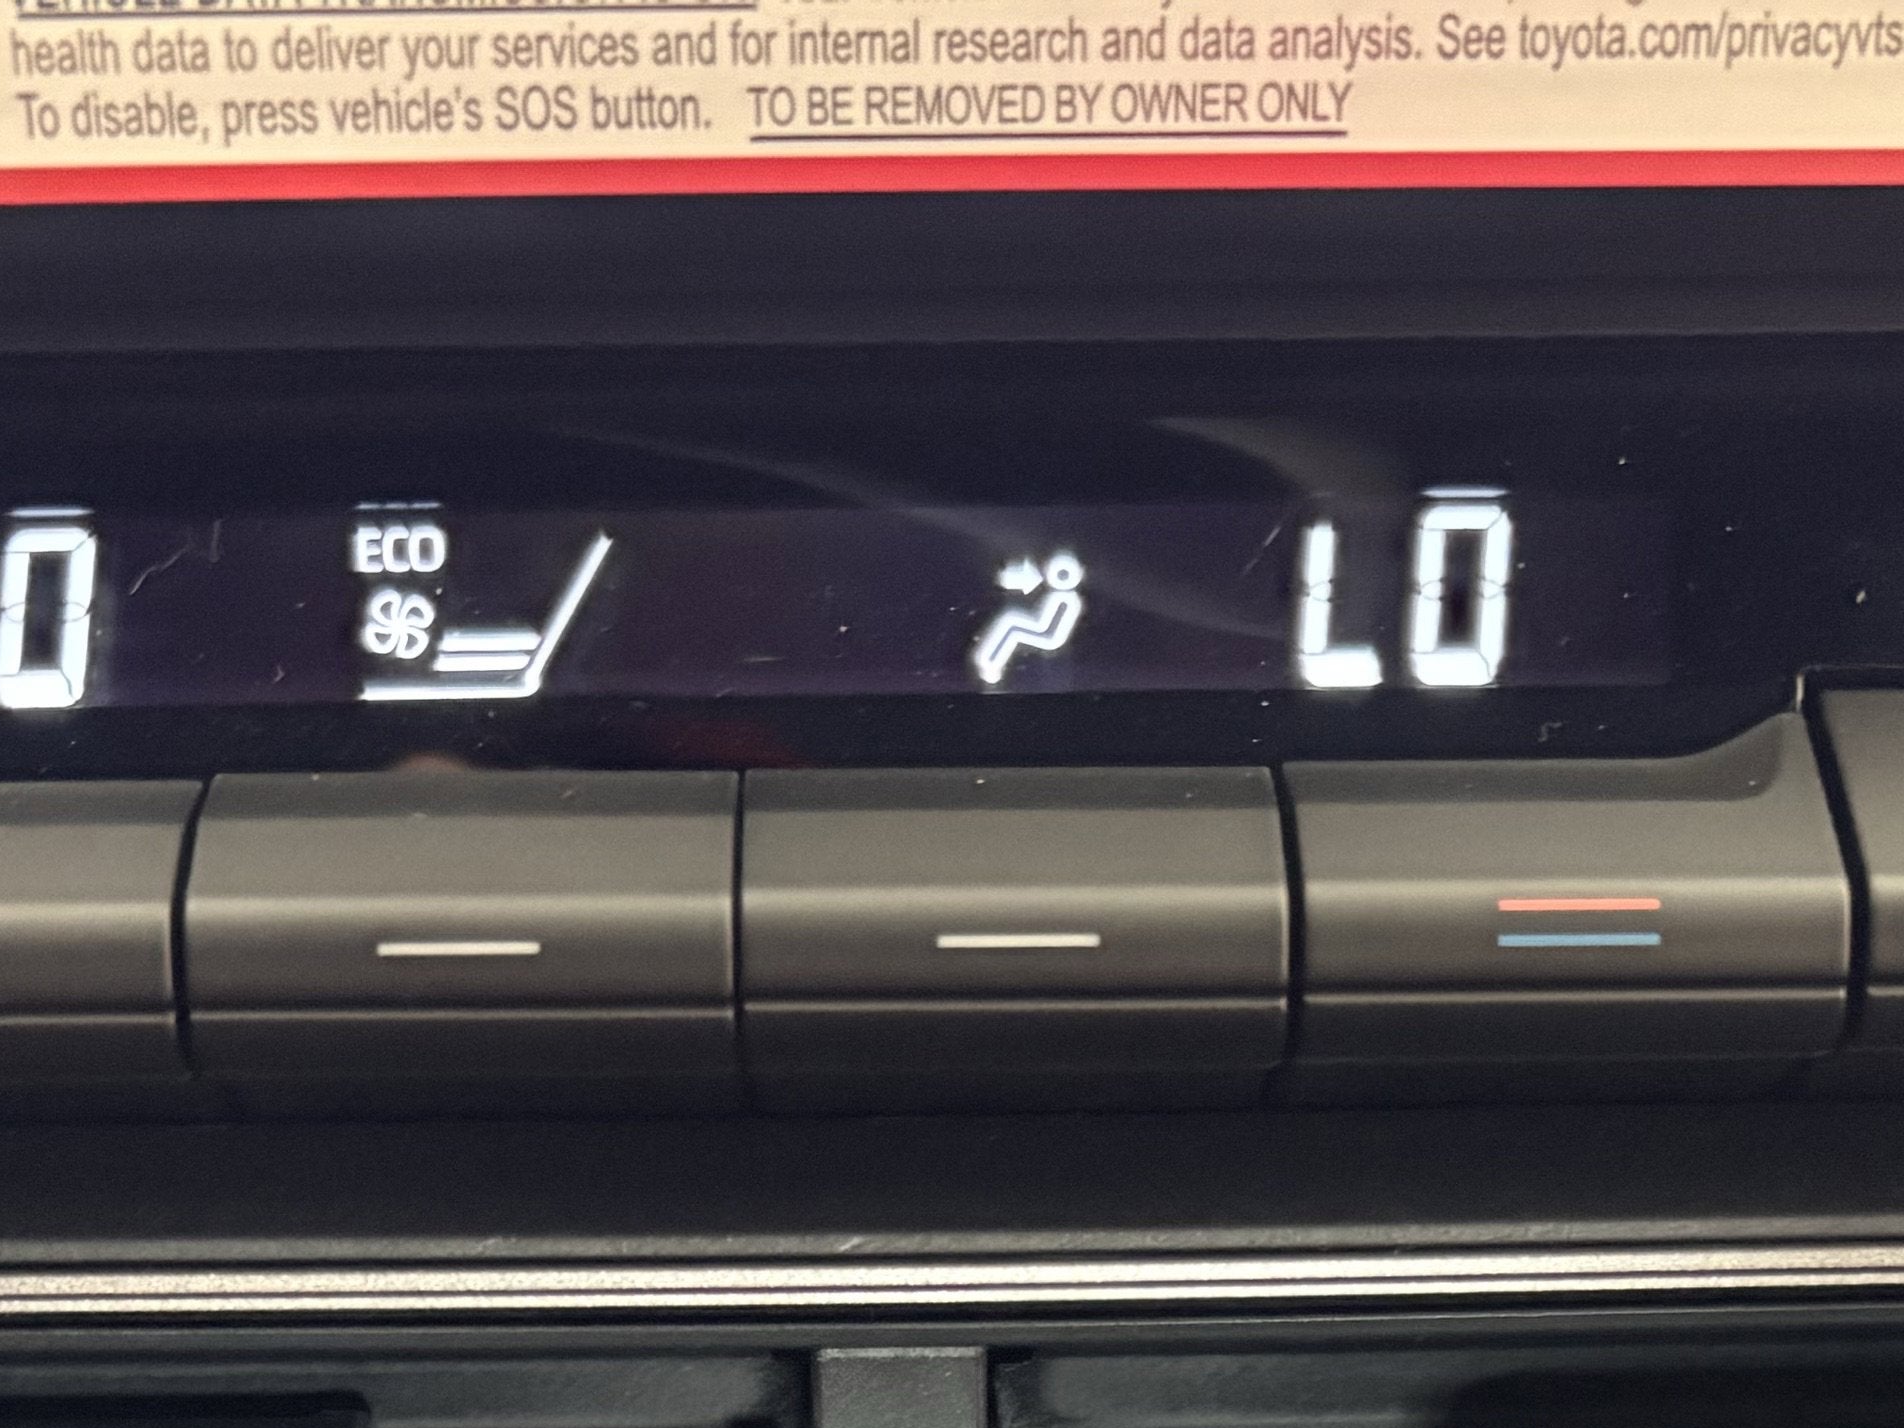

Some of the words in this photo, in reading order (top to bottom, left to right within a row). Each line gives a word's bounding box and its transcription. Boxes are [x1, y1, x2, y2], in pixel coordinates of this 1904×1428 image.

[10, 30, 121, 75] health
[132, 29, 211, 74] data
[223, 29, 258, 74] to
[271, 26, 391, 72] deliver
[401, 34, 481, 82] your
[492, 22, 639, 69] services
[652, 21, 717, 66] and
[729, 19, 779, 65] for
[789, 18, 920, 64] internal
[934, 16, 1087, 63] research
[1101, 16, 1166, 62] and
[1180, 16, 1255, 61] data
[1268, 12, 1422, 72] analysis.
[1437, 12, 1506, 61] See
[15, 92, 60, 138] To
[70, 91, 209, 142] disable,
[221, 98, 318, 147] press
[329, 86, 483, 133] vehicle's
[495, 84, 578, 131] SOS
[590, 86, 711, 130] button.
[746, 85, 796, 126] TO
[807, 86, 853, 126] BE
[865, 83, 1045, 126] REMOVED
[1056, 83, 1104, 123] BY
[1111, 82, 1247, 124] OWNER
[1258, 81, 1353, 122] ONLY
[354, 525, 446, 573] ECO
[1297, 504, 1512, 690] LO
